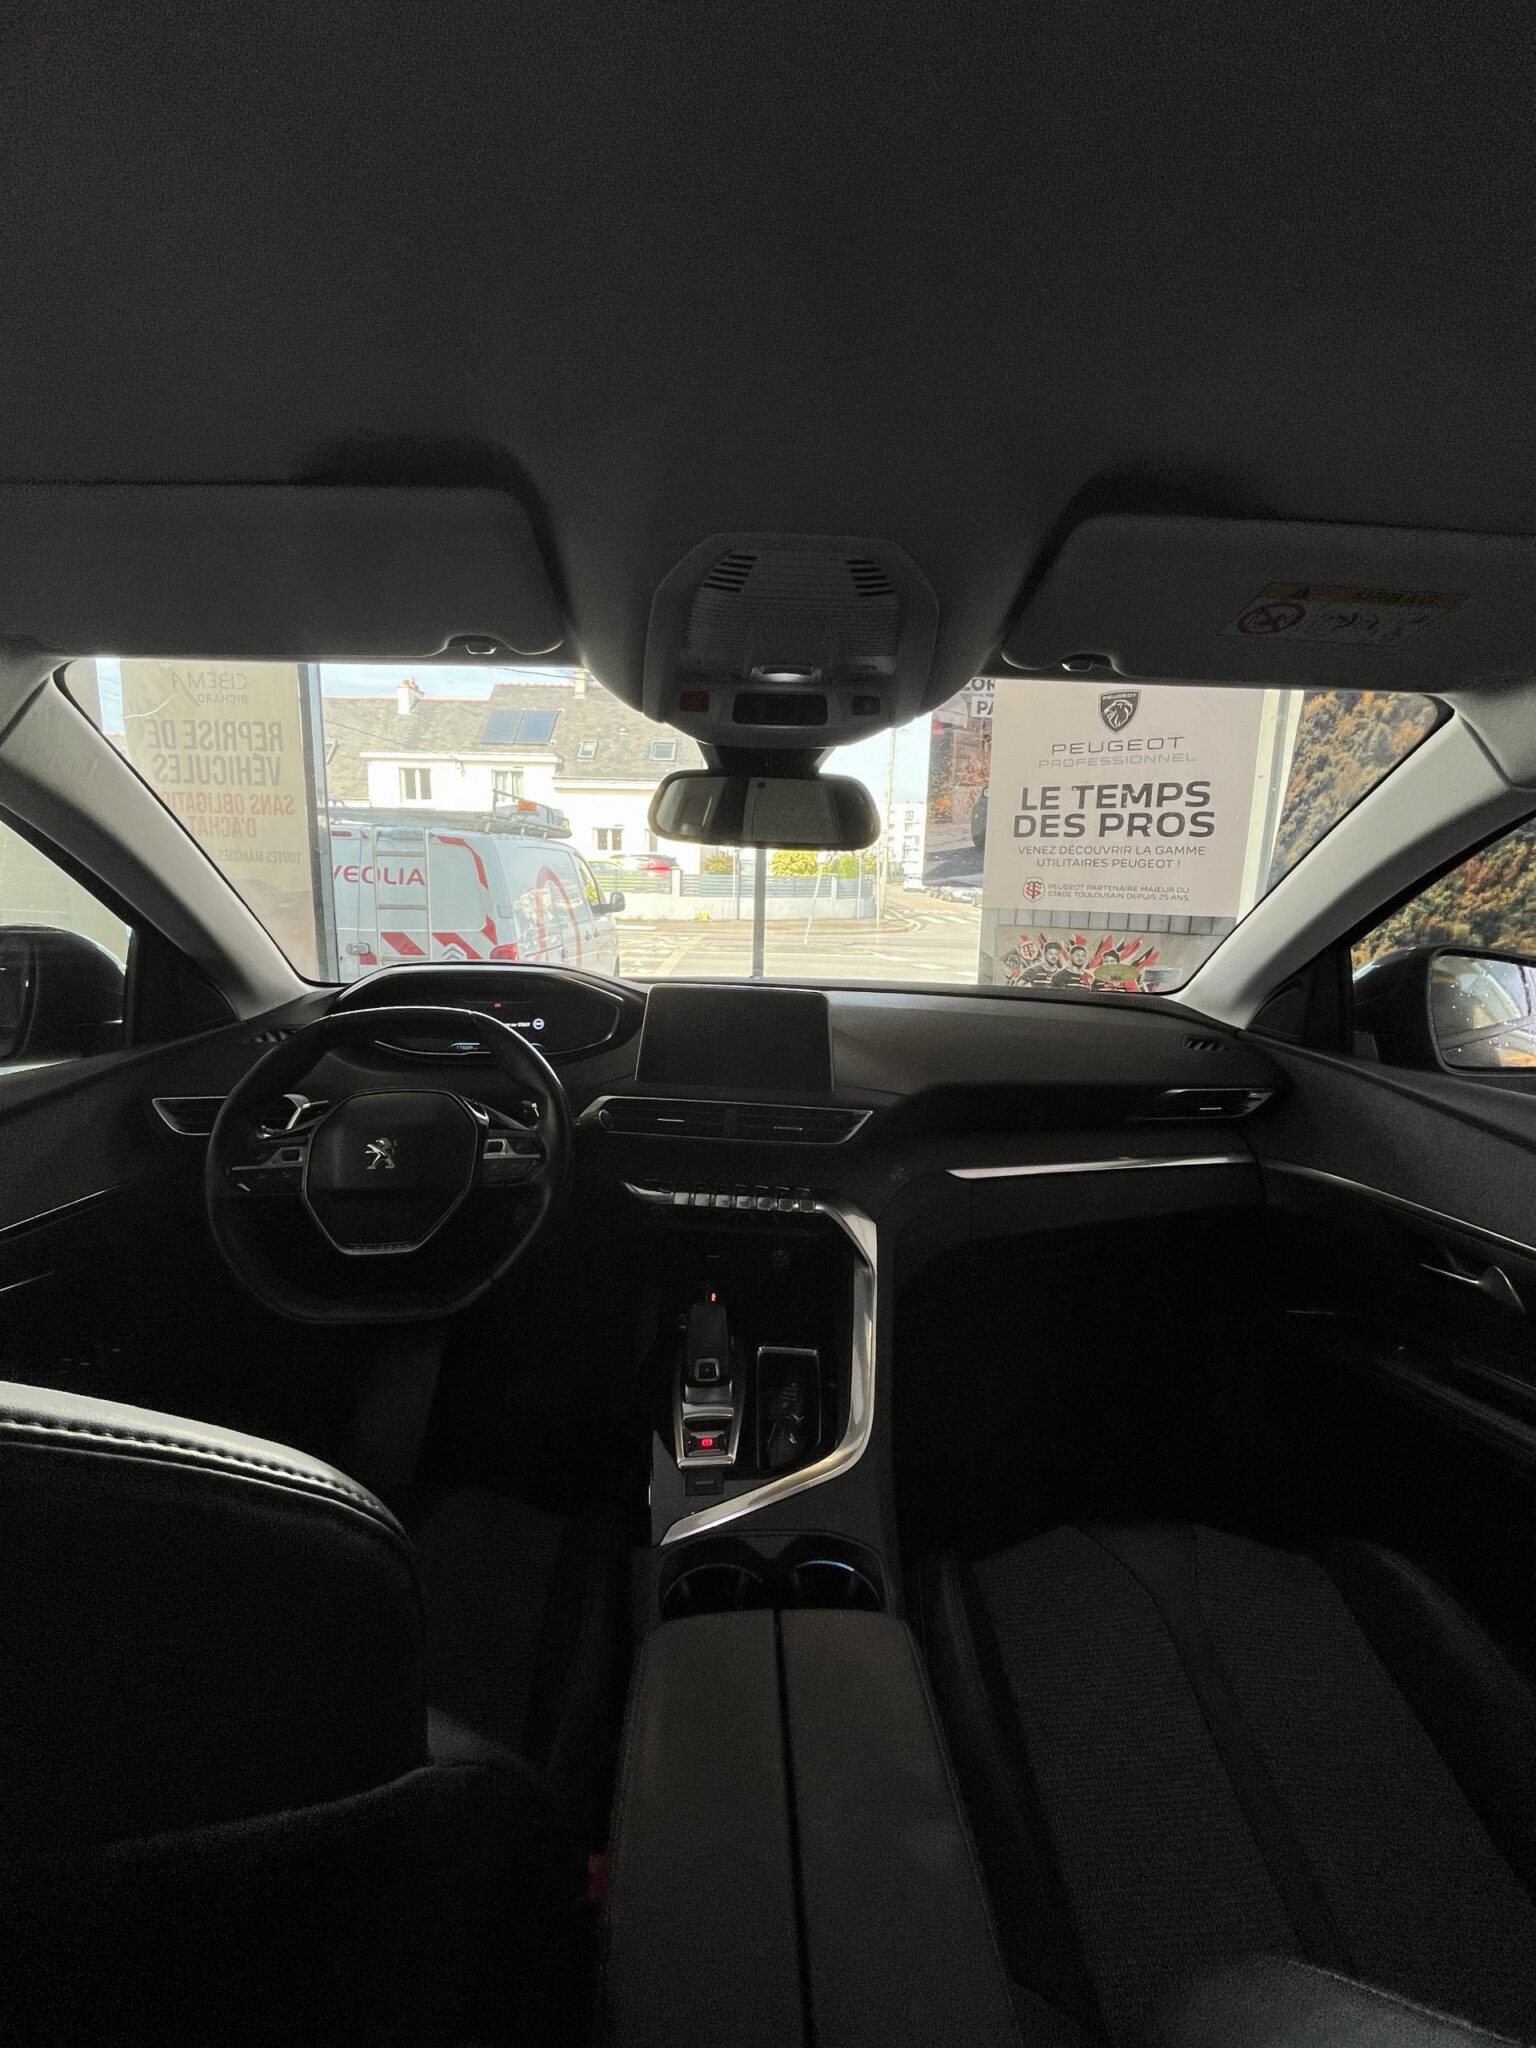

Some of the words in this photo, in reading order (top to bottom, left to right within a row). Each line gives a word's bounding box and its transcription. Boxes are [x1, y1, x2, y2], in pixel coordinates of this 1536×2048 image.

[1051, 736, 1185, 756] PEUGEOT
[1038, 752, 1197, 768] PROFESSIONNEL
[1021, 786, 1061, 811] LE
[1071, 780, 1211, 809] TEMPS
[1013, 813, 1086, 838] DES
[1099, 811, 1215, 838] PROS
[1018, 845, 1056, 855] VENEZ
[1062, 844, 1132, 855] DÉCOUVRIR
[1135, 845, 1152, 855] LA
[1155, 846, 1207, 856] GAMME
[1036, 858, 1108, 868] UTILITAIRES
[1112, 858, 1174, 869] PEUGEOT
[1047, 883, 1085, 891] PEUGEOT
[1086, 884, 1139, 893] PARTENAIRE
[1140, 886, 1175, 894] MAJEUR
[1176, 887, 1189, 895] DU
[1074, 891, 1125, 900] TOULOUSAIN
[1127, 893, 1157, 901] DEPUIS
